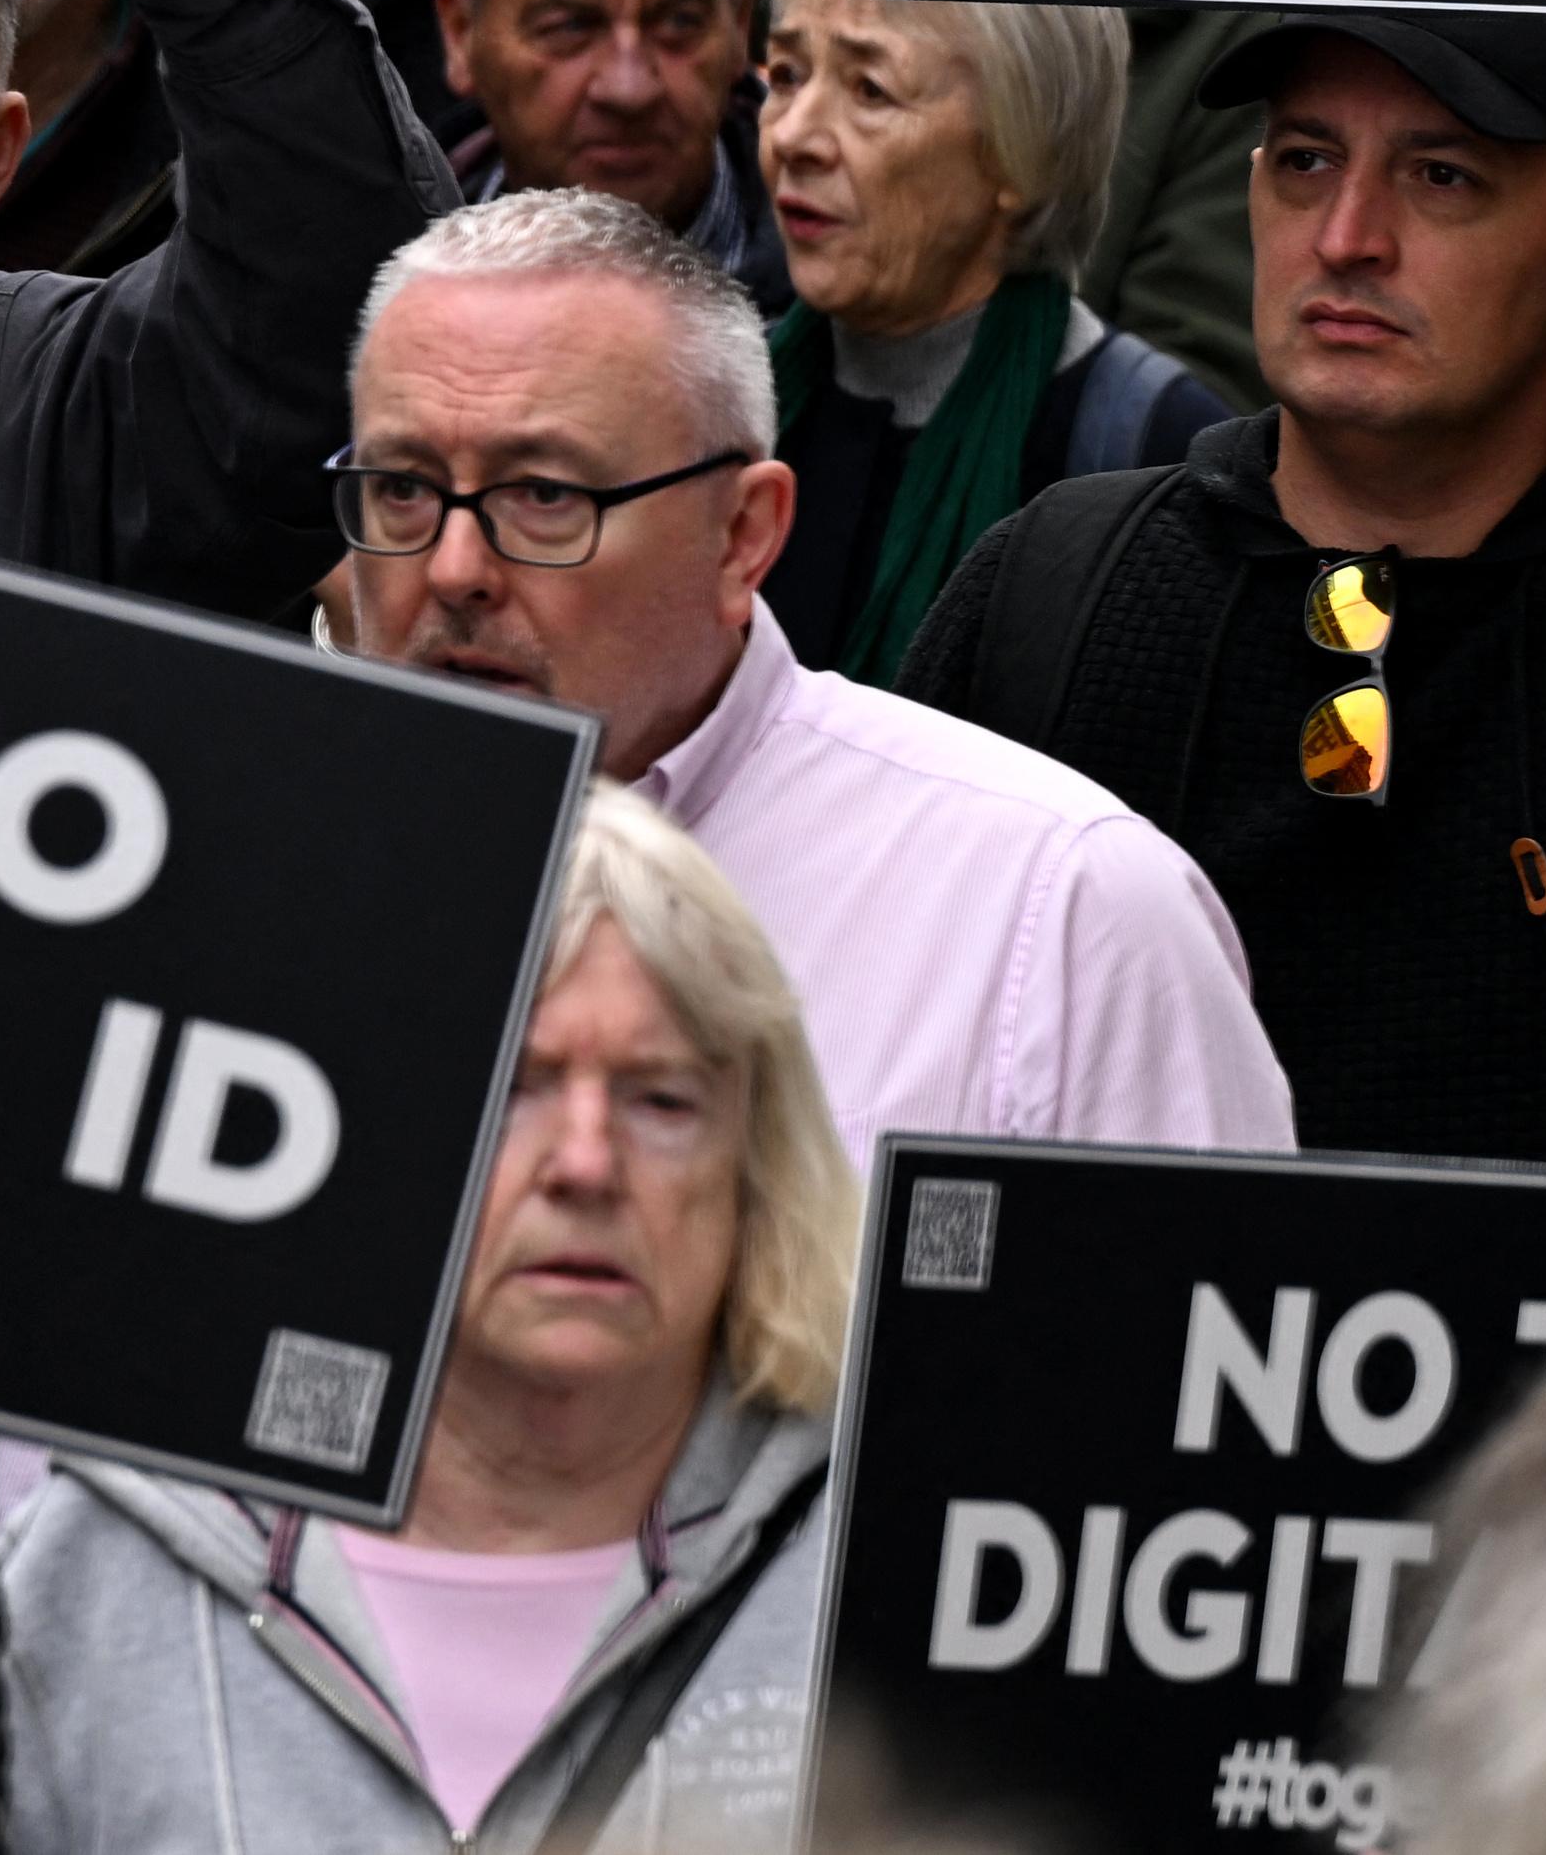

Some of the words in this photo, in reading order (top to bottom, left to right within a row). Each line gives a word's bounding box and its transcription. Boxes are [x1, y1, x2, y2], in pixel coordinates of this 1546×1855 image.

[63, 998, 341, 1224] ID
[1173, 1282, 1455, 1464] NO
[928, 1497, 1439, 1688] DIGIT
